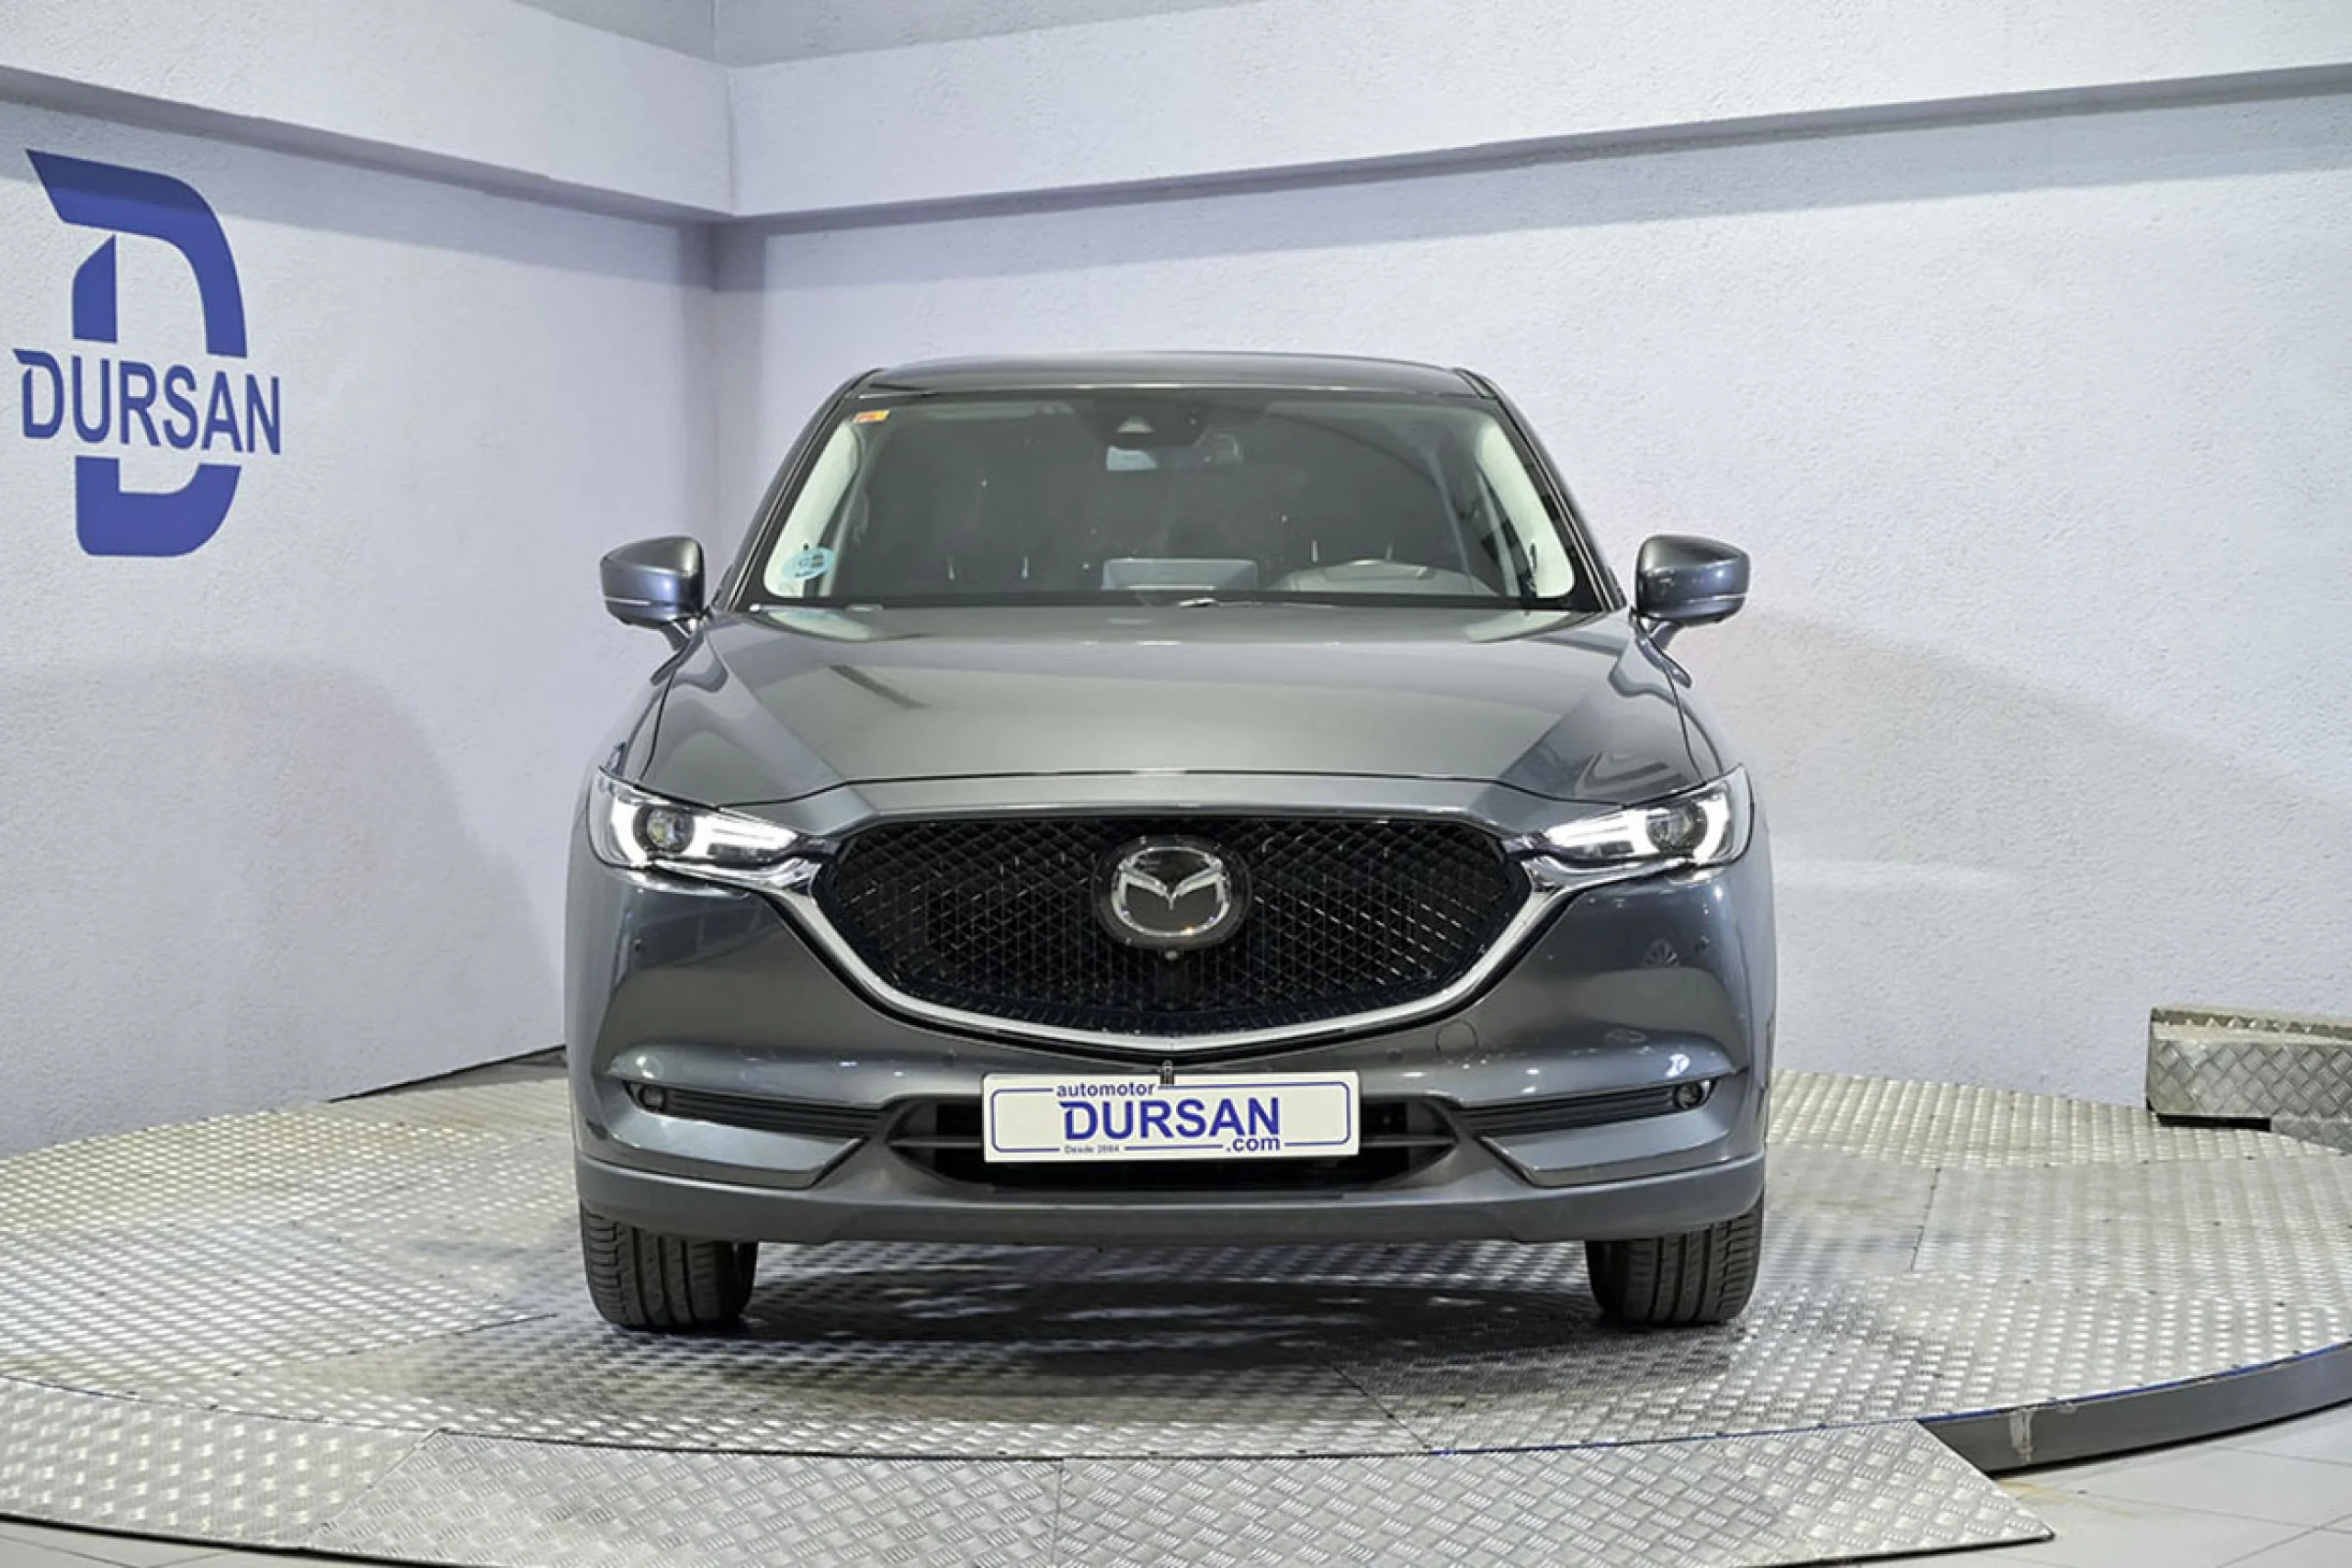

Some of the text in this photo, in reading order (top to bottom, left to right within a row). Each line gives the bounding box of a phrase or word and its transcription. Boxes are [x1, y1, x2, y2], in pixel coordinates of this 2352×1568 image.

[13, 349, 280, 456] DURSAN
[1056, 1082, 1155, 1097] automotor
[1058, 1098, 1280, 1140] DURSAN
[1226, 1137, 1281, 1152] .com
